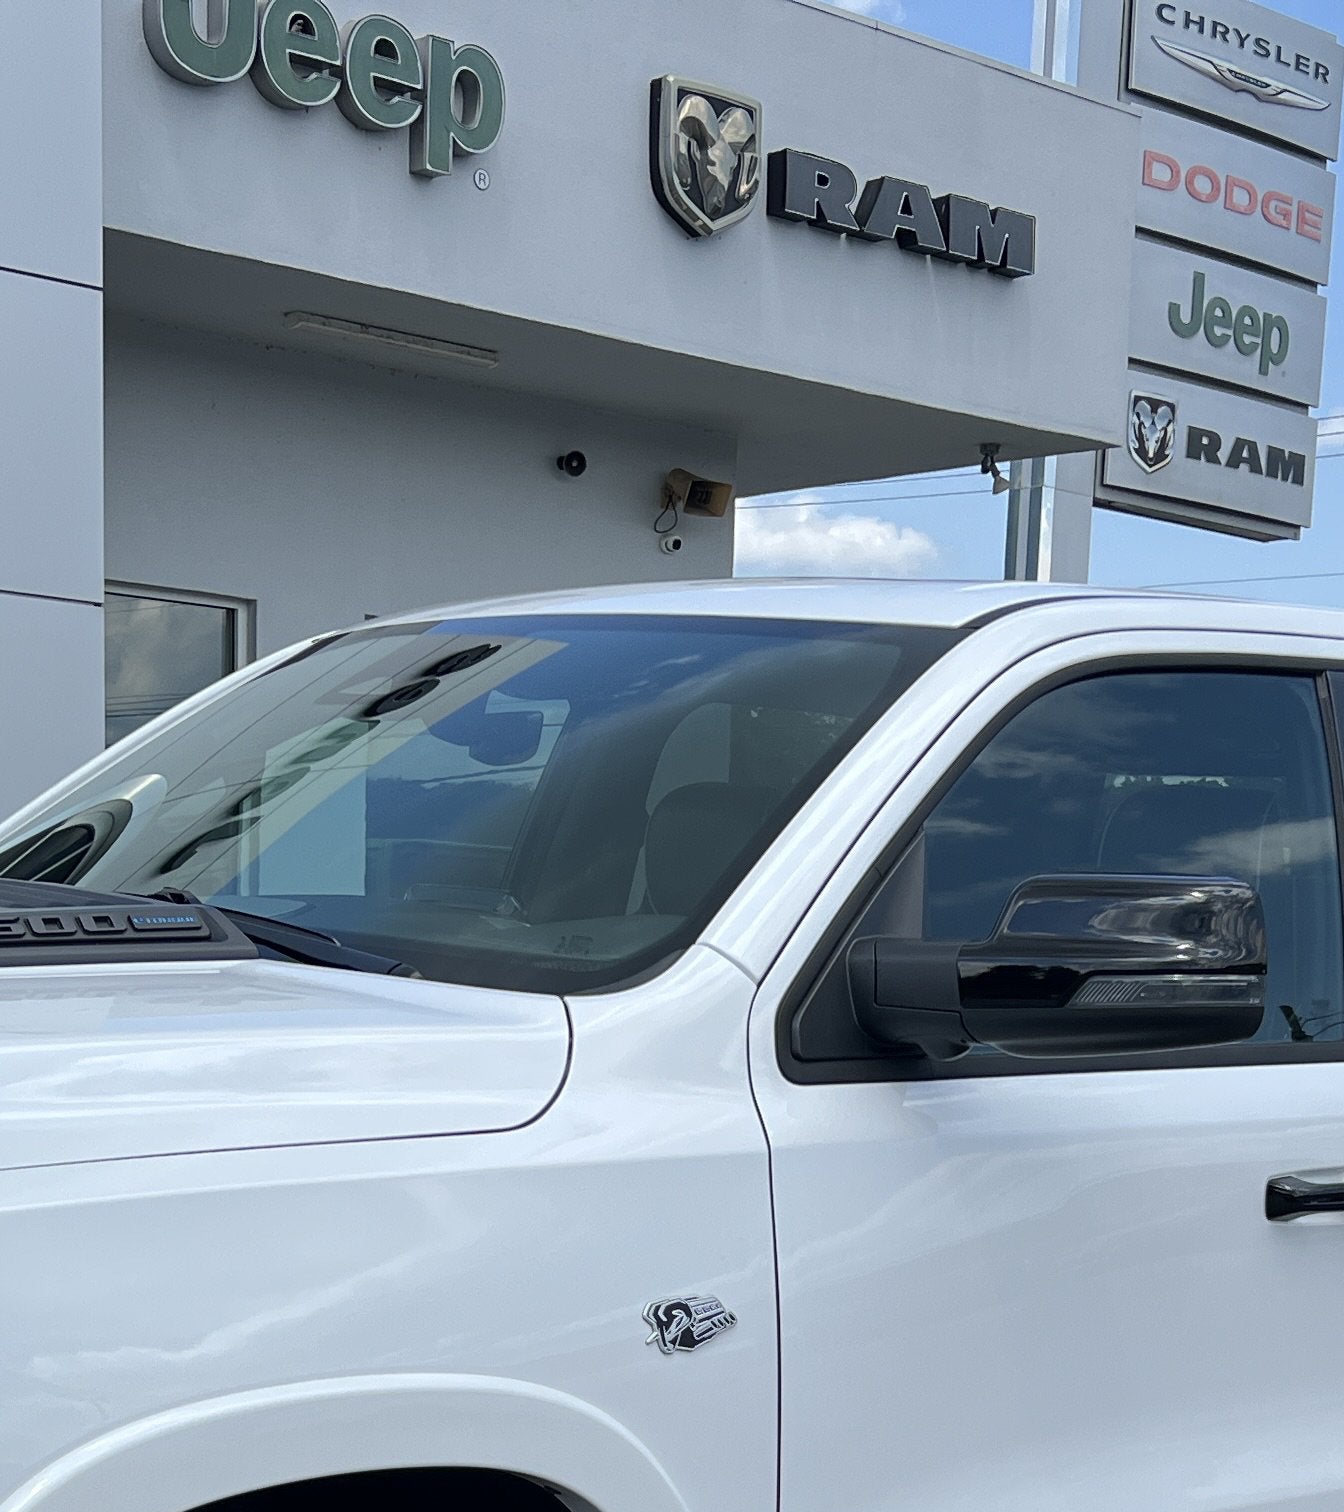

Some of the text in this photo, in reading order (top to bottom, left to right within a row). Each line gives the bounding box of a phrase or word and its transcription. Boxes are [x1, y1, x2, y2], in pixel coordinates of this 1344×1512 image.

[1155, 3, 1331, 84] CHRYSLER
[767, 147, 1037, 279] RAM
[1142, 149, 1325, 242] DODGE
[1168, 271, 1290, 376] Jeep
[1185, 425, 1306, 487] RAM
